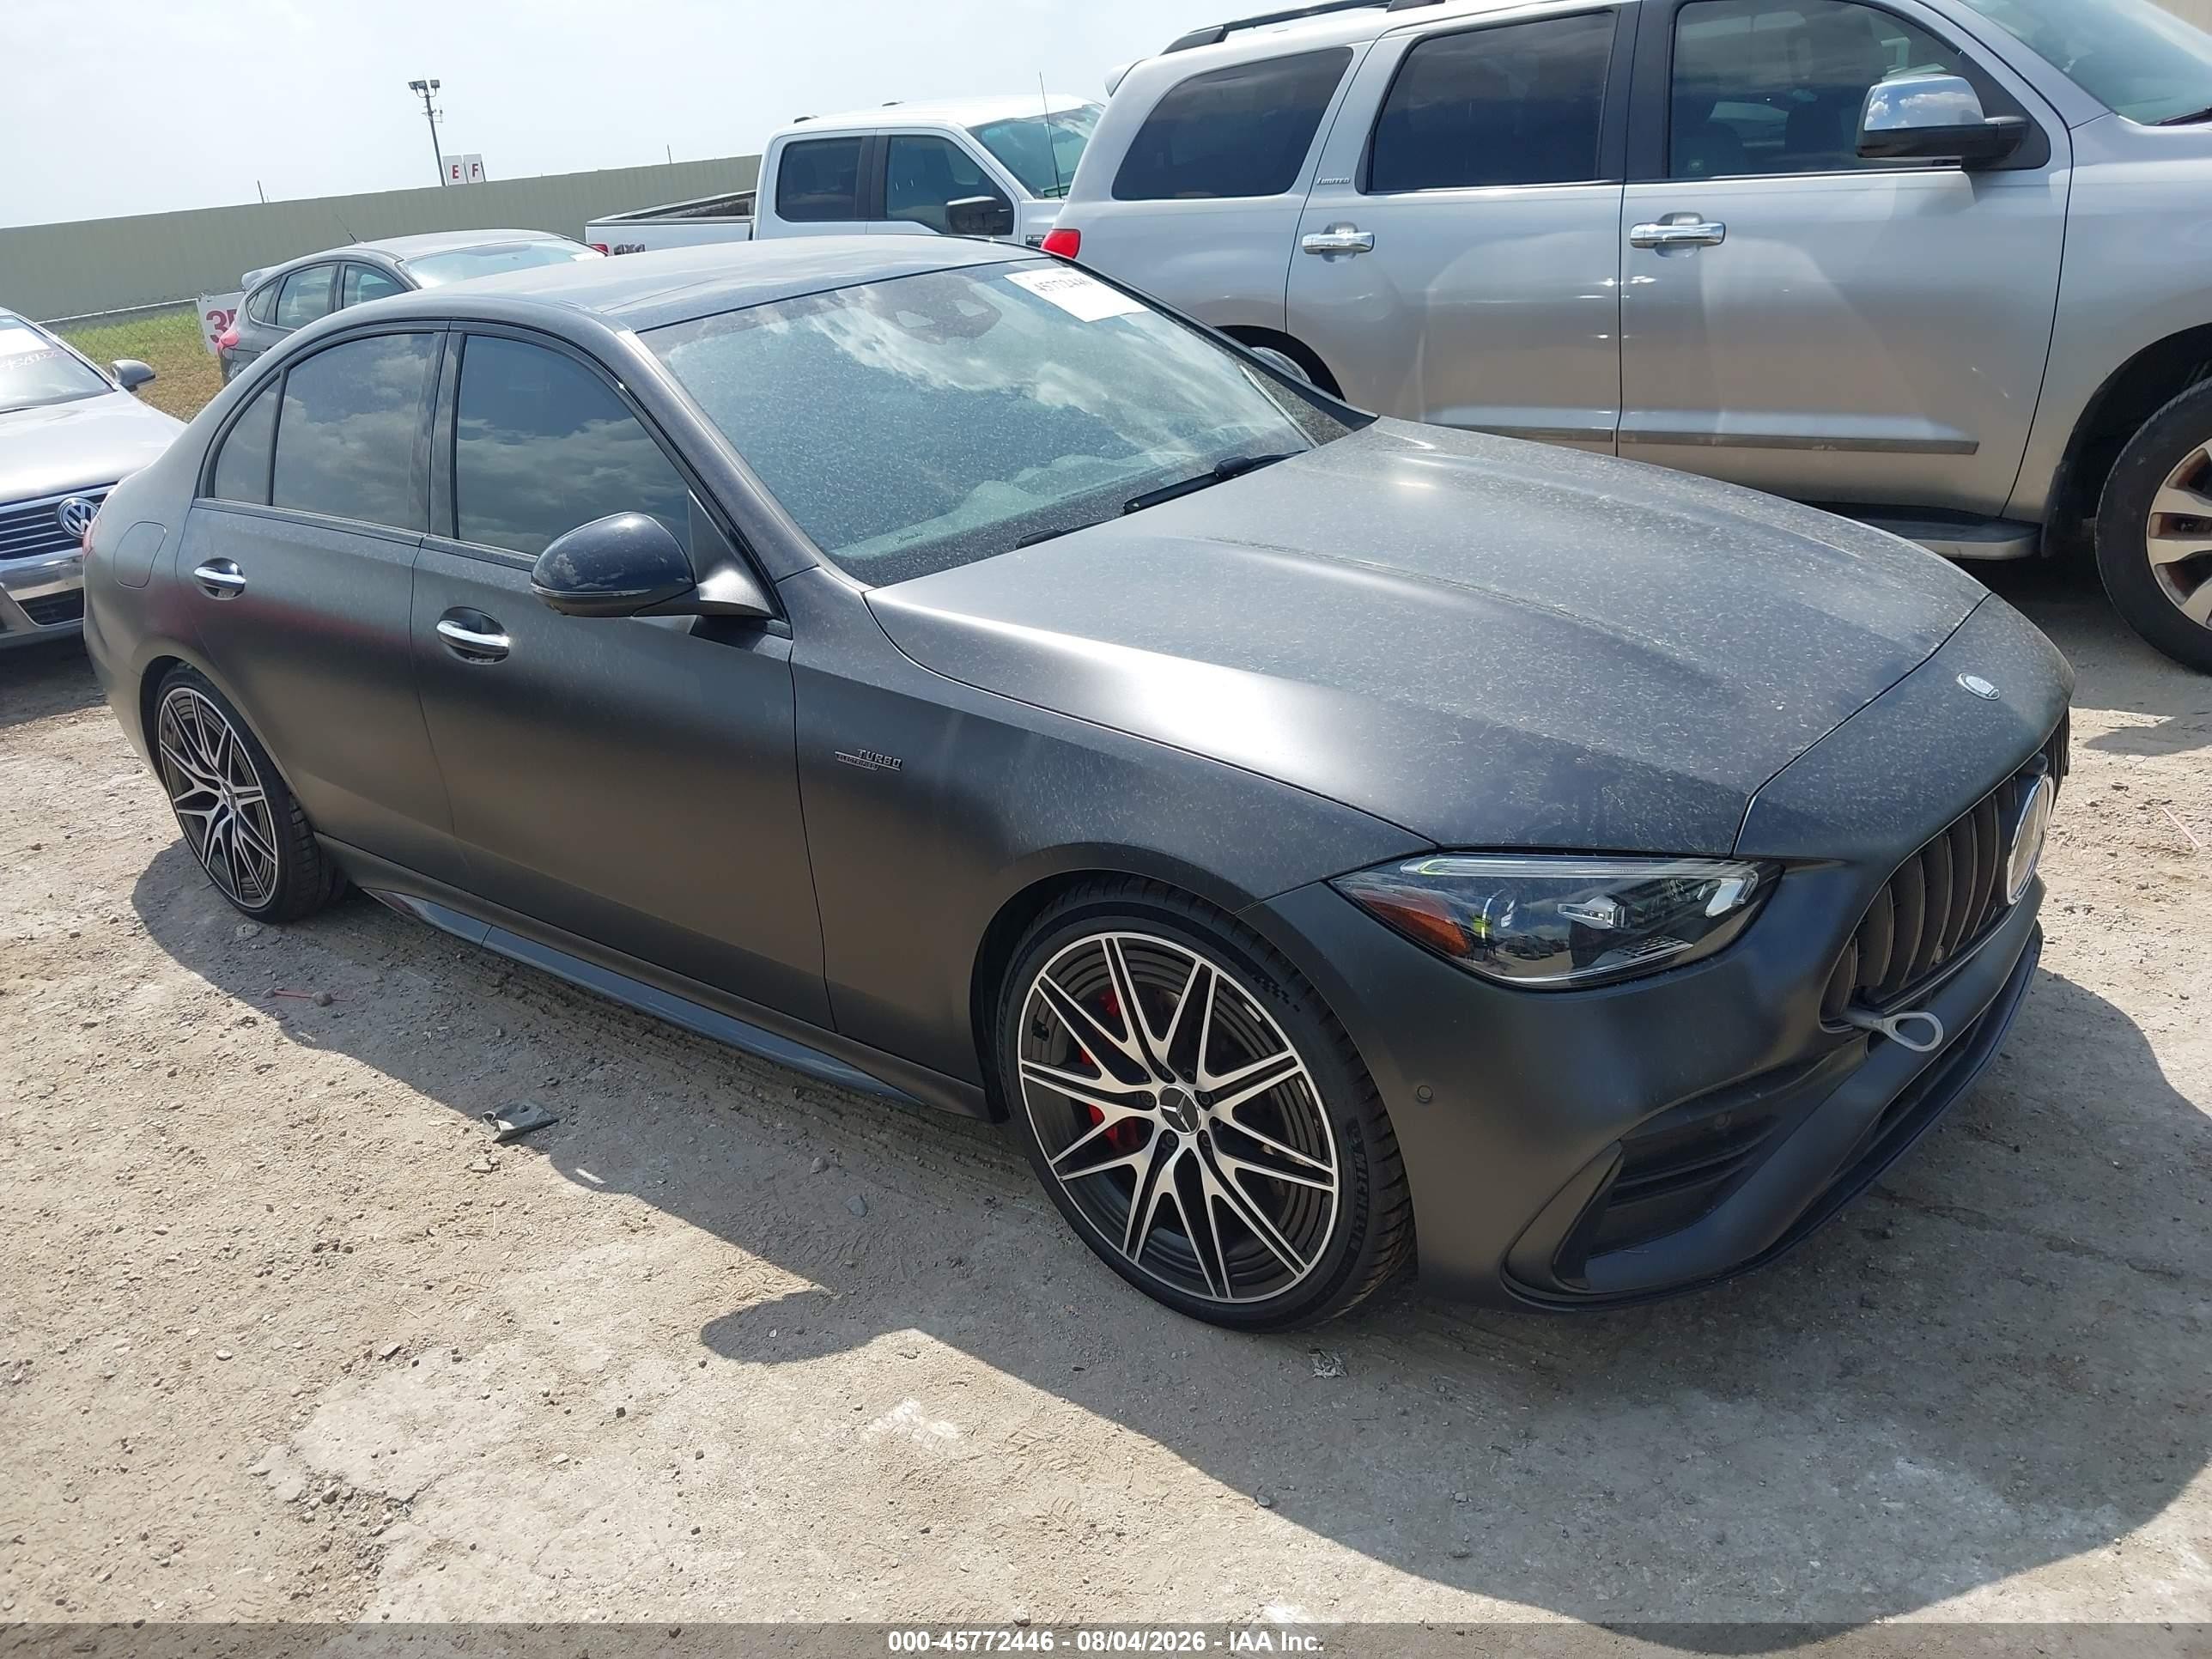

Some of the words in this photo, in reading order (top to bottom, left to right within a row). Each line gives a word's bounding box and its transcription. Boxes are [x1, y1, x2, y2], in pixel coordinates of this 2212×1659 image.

[452, 164, 459, 179] E
[471, 163, 479, 178] F
[837, 755, 877, 769] ELECTRIFIED
[857, 749, 902, 768] TURBO
[1349, 1152, 1369, 1251] MICHELIN
